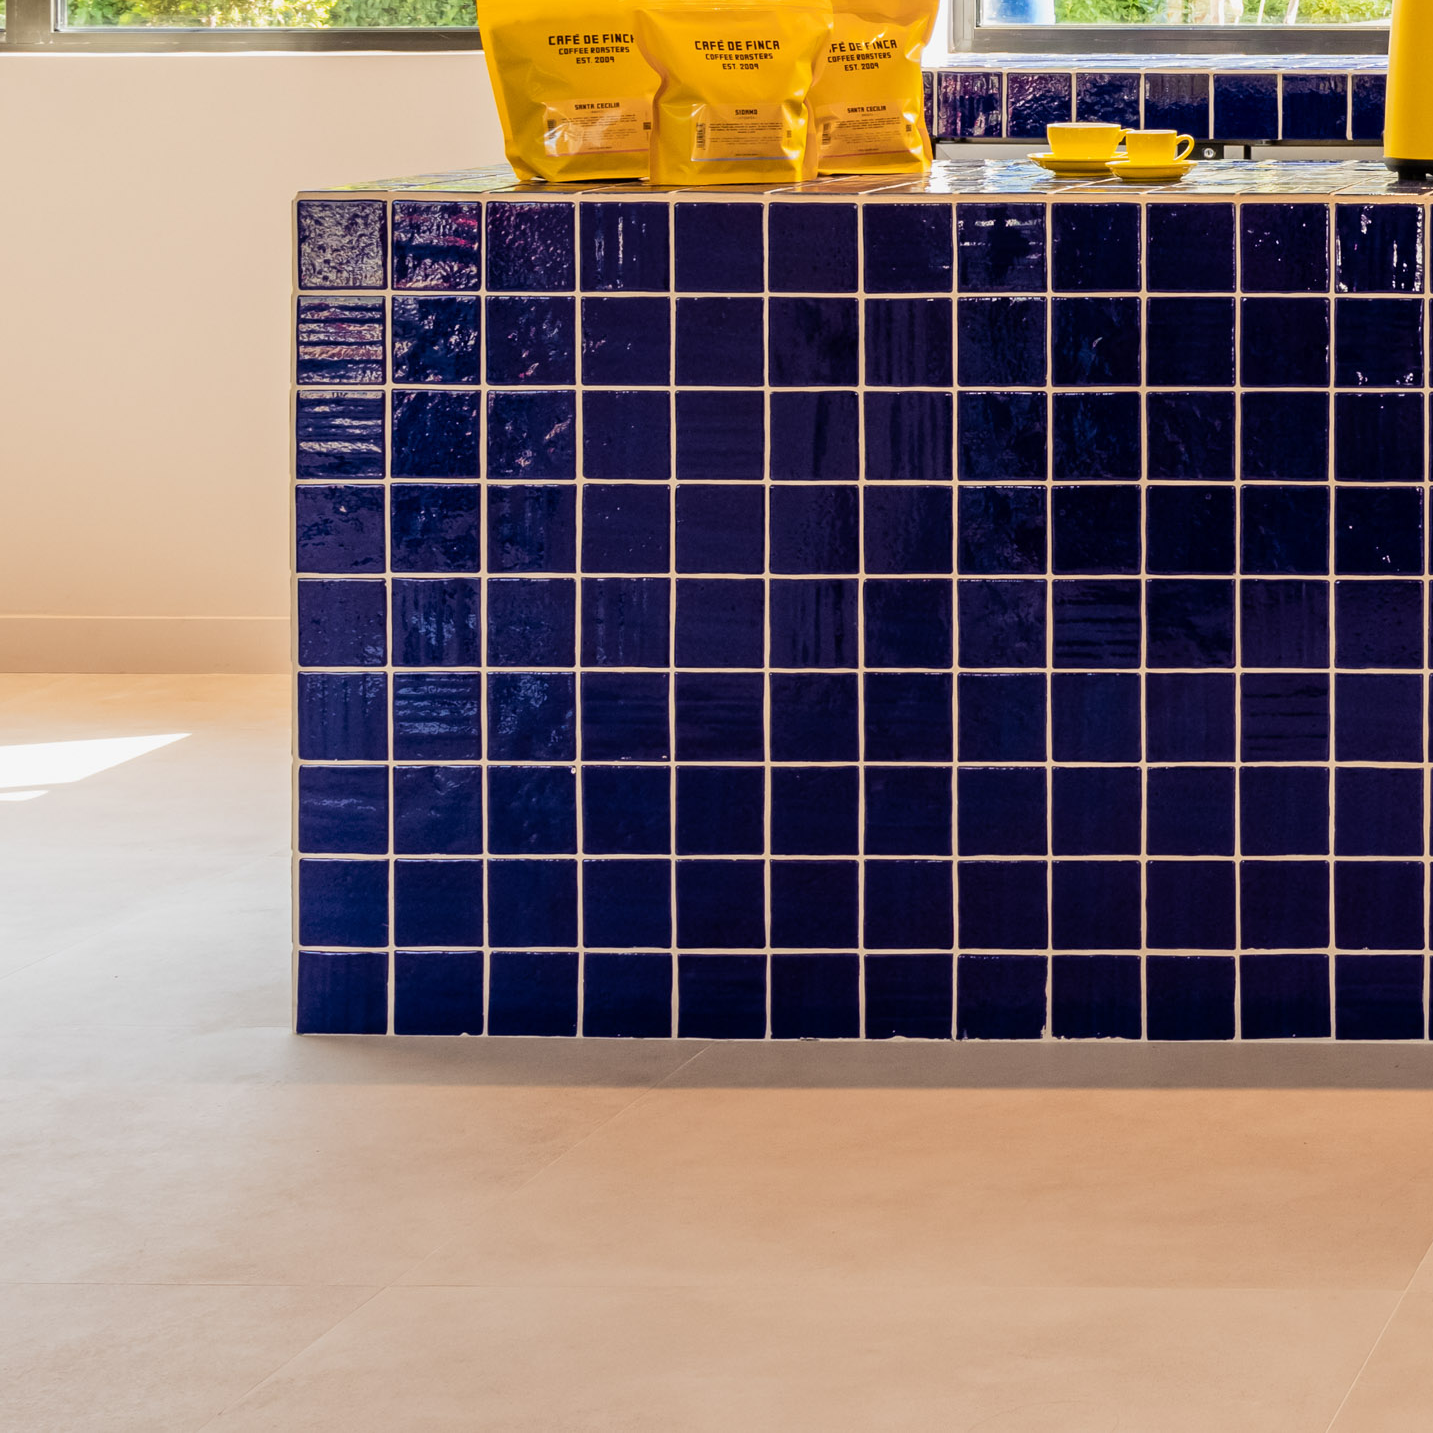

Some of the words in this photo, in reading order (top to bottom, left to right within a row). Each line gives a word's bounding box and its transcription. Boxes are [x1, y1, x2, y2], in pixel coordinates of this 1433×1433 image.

[548, 34, 580, 45] CAFÉ
[583, 34, 599, 44] DE
[694, 39, 725, 50] CAFÉ
[727, 41, 743, 51] DE
[745, 40, 780, 50] FINCA
[558, 47, 589, 55] COFFEE
[590, 46, 630, 54] ROASTERS
[829, 41, 846, 53] FÉ
[848, 42, 863, 52] DE
[827, 54, 855, 63] COFFEE
[856, 52, 892, 61] ROASTERS
[861, 62, 879, 70] 2009
